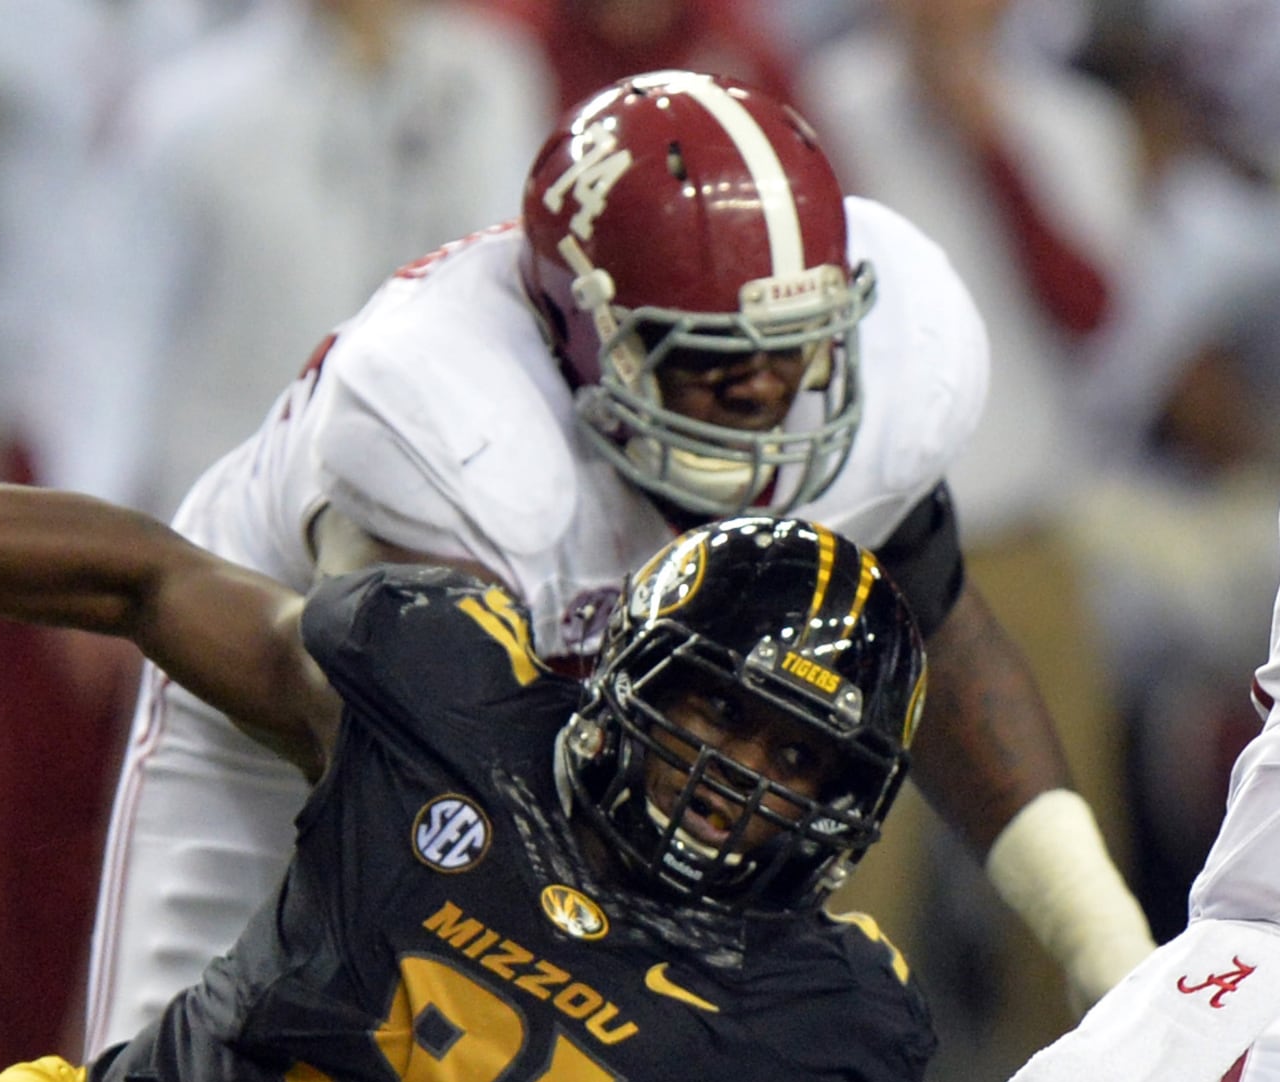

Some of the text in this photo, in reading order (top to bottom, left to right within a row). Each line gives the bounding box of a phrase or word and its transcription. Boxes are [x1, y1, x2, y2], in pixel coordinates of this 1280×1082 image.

[782, 651, 841, 694] TIGERS
[417, 800, 485, 868] SEC
[422, 901, 639, 1044] MIZZOU
